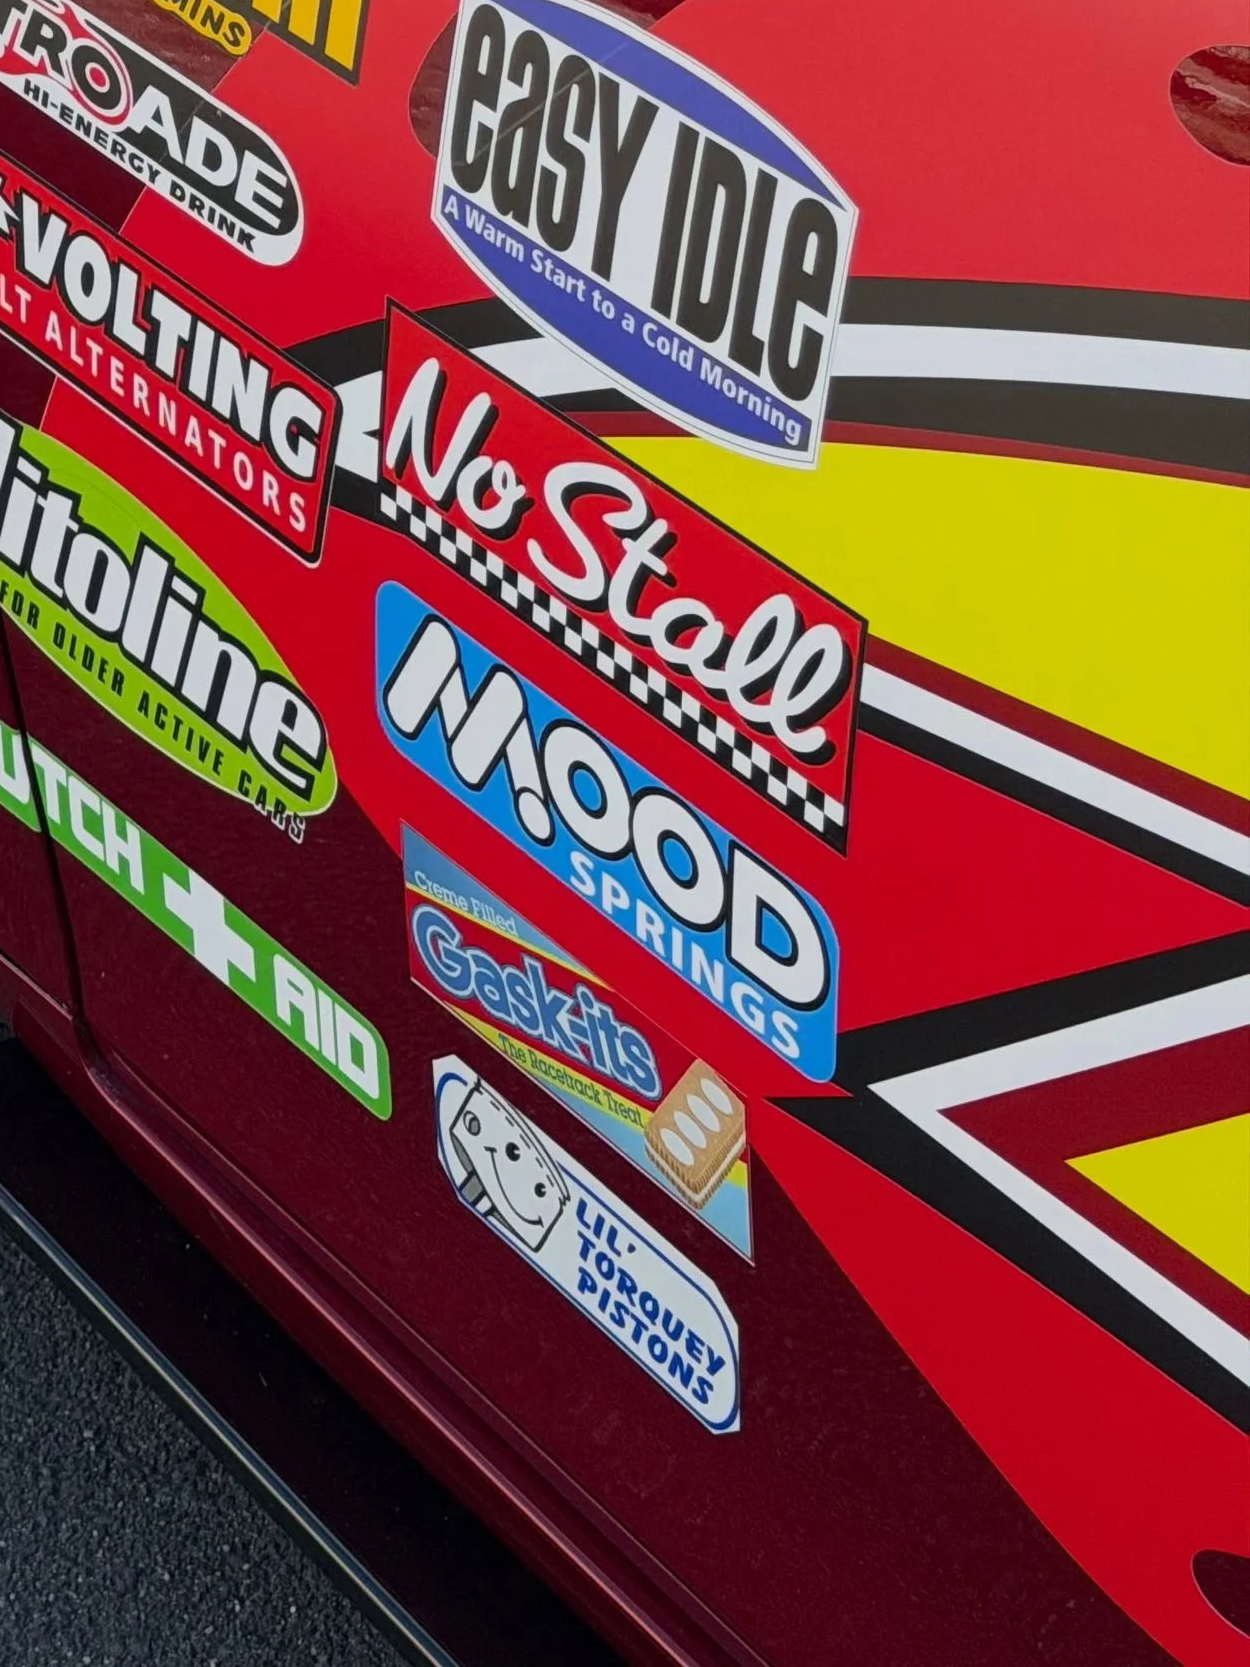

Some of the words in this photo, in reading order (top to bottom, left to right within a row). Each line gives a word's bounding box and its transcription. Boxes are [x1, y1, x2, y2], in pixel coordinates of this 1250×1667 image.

[24, 80, 160, 182] HI-ENERGY
[169, 181, 255, 254] DRINK
[443, 194, 460, 217] A
[464, 208, 525, 264] Warm
[530, 248, 586, 304] Start
[591, 288, 616, 320] to
[621, 309, 636, 333] a
[642, 322, 694, 372] Cold
[700, 358, 803, 447] Morning
[45, 311, 307, 533] ALTERNATORS
[385, 357, 529, 534] No
[527, 462, 830, 756] Stall
[51, 620, 125, 696] OLDER
[137, 691, 225, 777] ACTIVE
[236, 769, 307, 844] CARS
[384, 614, 830, 1010] MOOD
[412, 903, 662, 1100] Gask-its
[414, 870, 468, 912] Creme
[470, 897, 519, 936] Filled
[569, 851, 799, 1059] SPRINGS
[274, 953, 380, 1101] AID
[498, 1033, 526, 1063] The
[527, 1048, 602, 1106] Racetrack
[603, 1091, 645, 1128] Treat
[577, 1230, 726, 1378] TORQUEY
[578, 1266, 714, 1405] PISTONS
